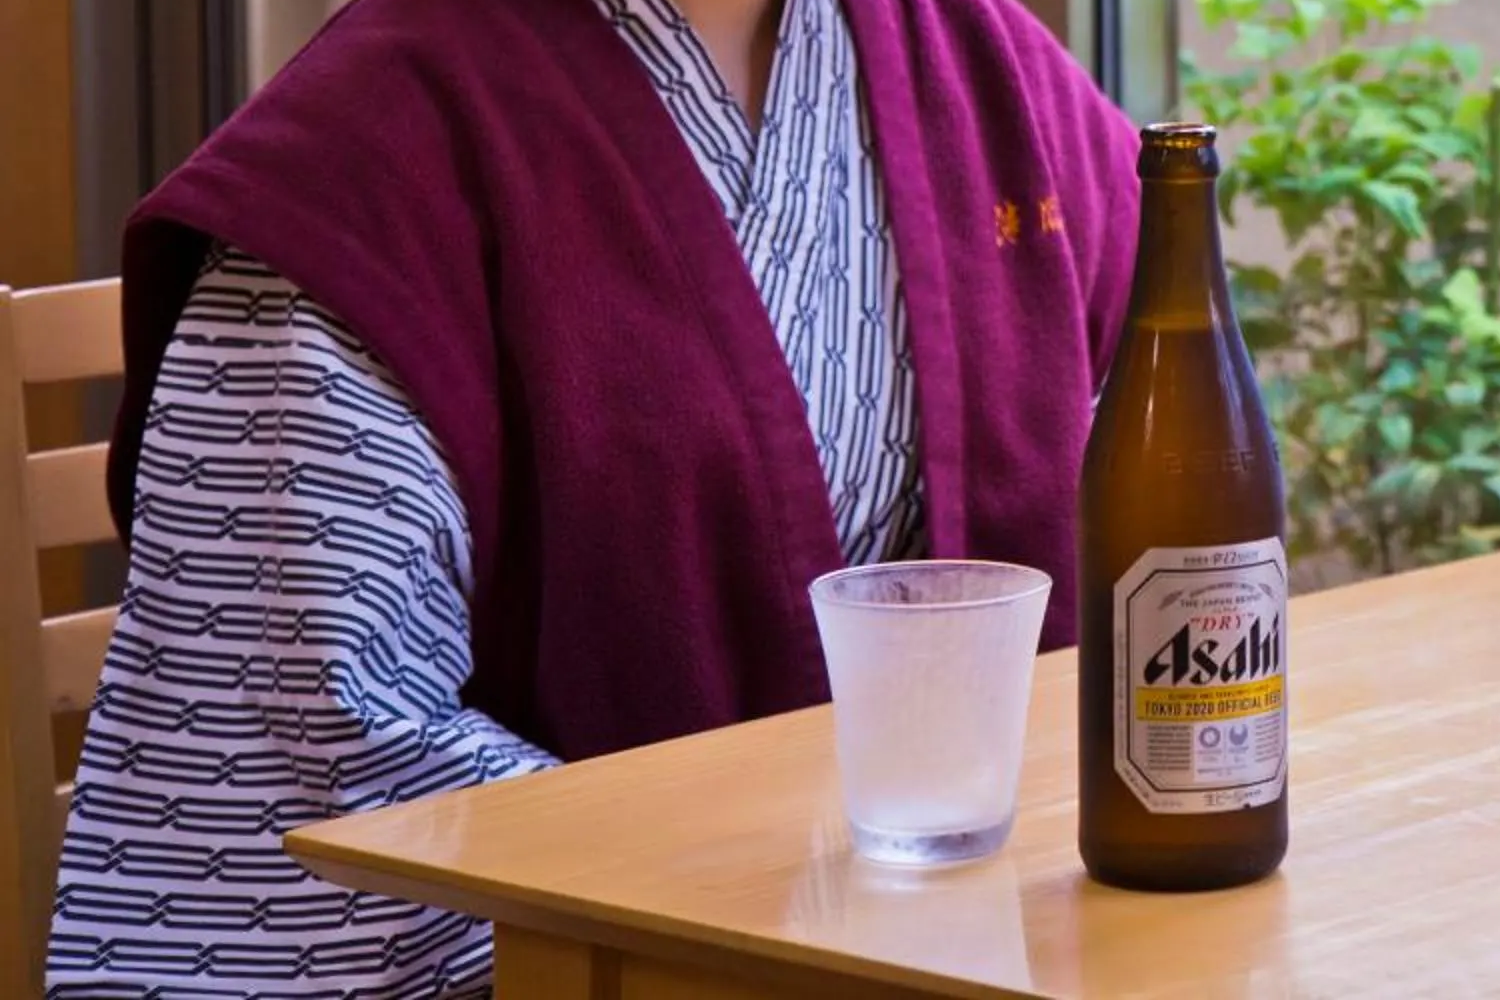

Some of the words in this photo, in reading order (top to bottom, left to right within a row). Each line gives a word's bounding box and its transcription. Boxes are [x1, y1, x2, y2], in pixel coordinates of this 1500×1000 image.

[1144, 612, 1279, 687] Asahi
[1145, 699, 1182, 716] TOKYO
[1185, 700, 1215, 715] 2020
[1217, 696, 1262, 713] OFFICIAL
